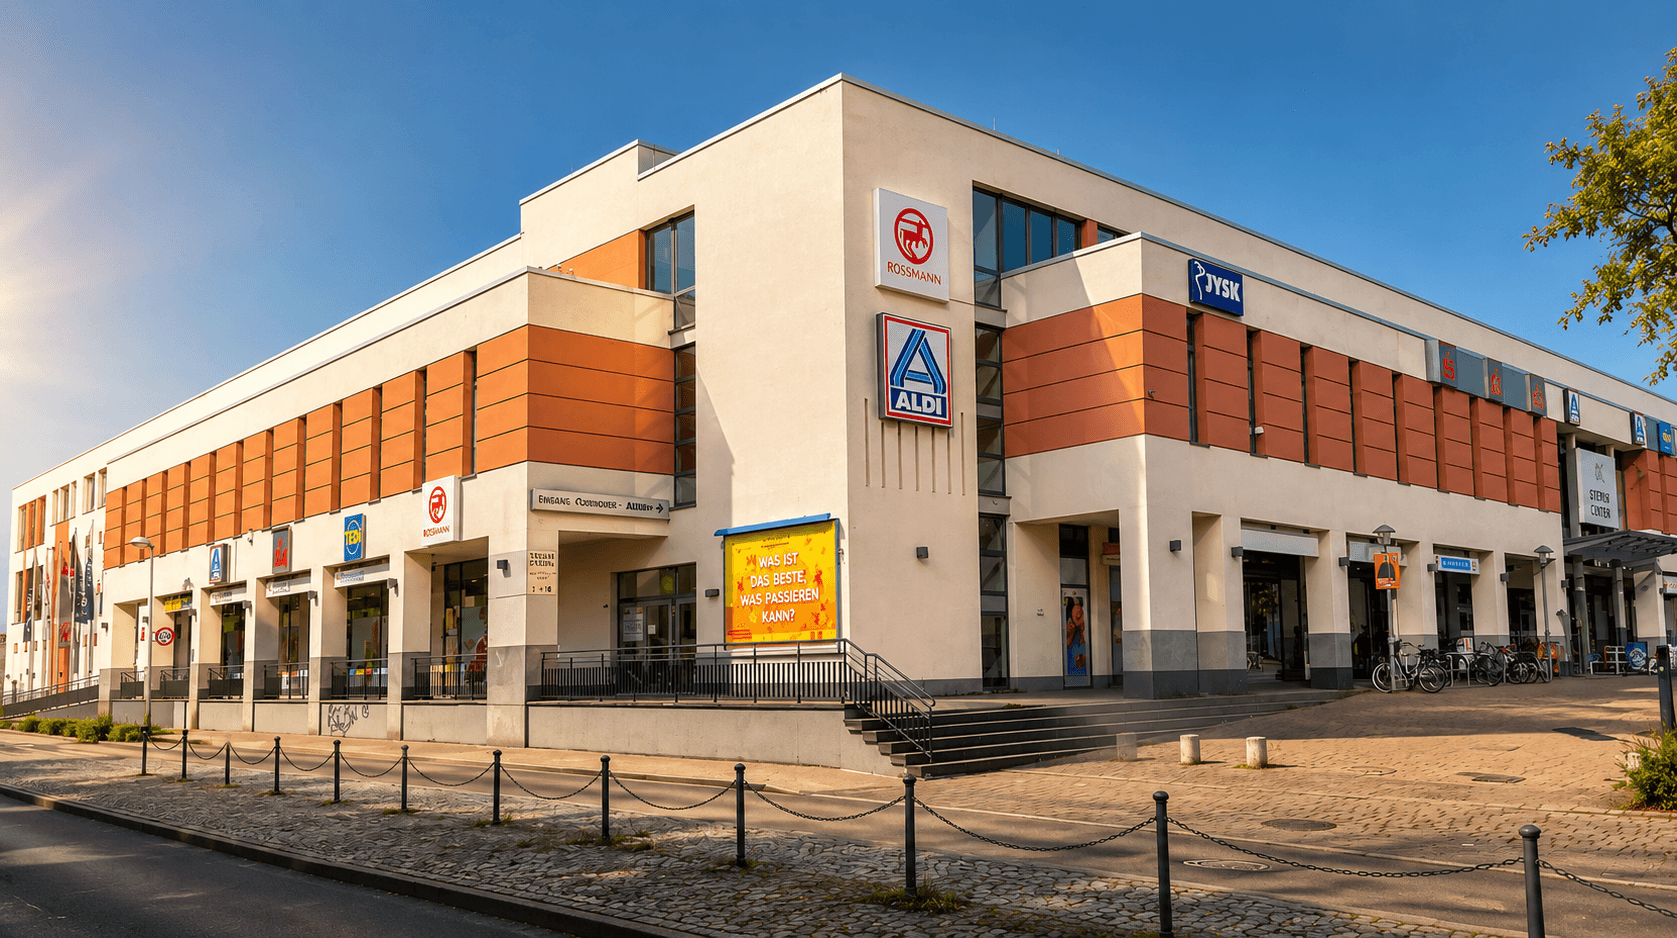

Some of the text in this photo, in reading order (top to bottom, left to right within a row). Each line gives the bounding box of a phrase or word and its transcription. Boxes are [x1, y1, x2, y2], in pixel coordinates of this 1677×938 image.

[887, 261, 942, 285] ROSSMANN
[1205, 272, 1241, 303] JYSK
[895, 391, 942, 415] ALDI
[758, 552, 799, 568] WAS IST
[750, 570, 807, 588] DAS BESTE,
[740, 587, 819, 606] WAS PASSIEREN
[762, 608, 795, 623] KANN?
